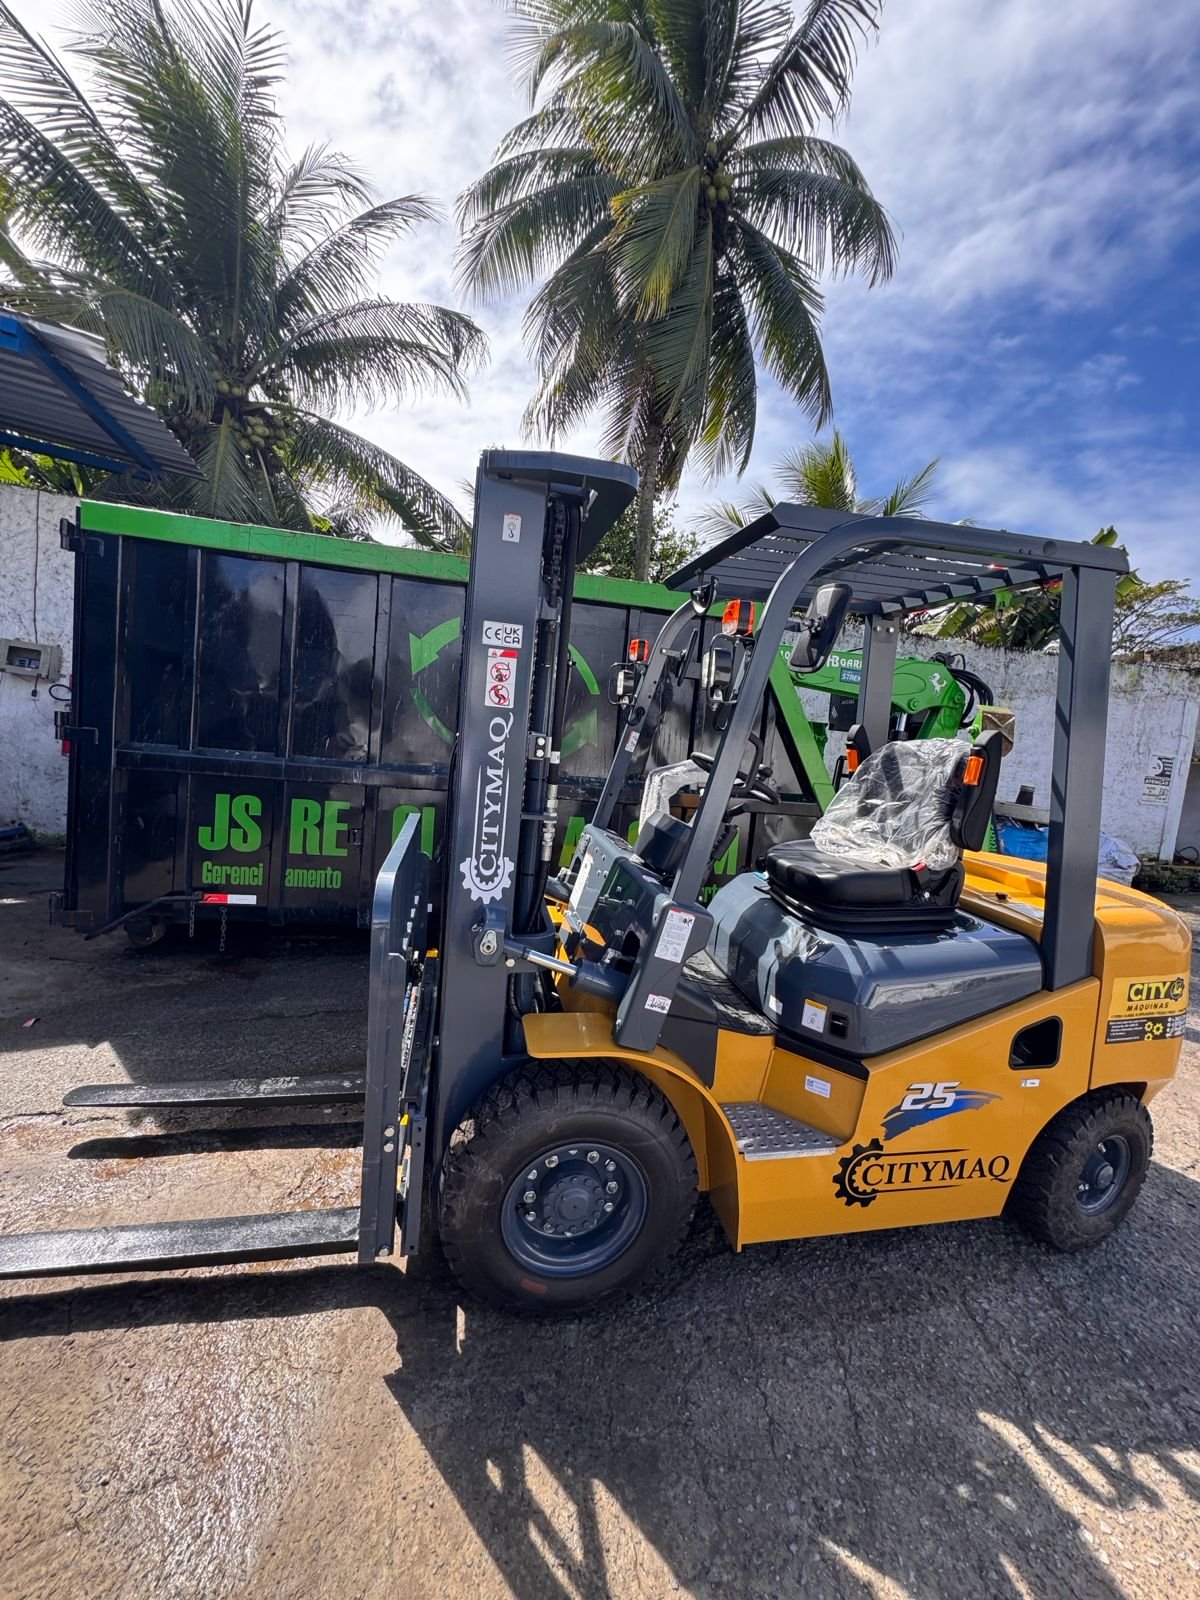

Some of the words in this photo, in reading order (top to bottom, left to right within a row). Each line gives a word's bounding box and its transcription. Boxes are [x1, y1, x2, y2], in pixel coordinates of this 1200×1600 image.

[503, 635, 521, 645] CA
[504, 626, 521, 637] UK
[478, 711, 515, 876] CITYMAQ
[197, 793, 262, 853] JS
[1129, 981, 1171, 1001] CITY
[900, 1081, 961, 1111] 25
[862, 1155, 1013, 1187] CITYMAQ
